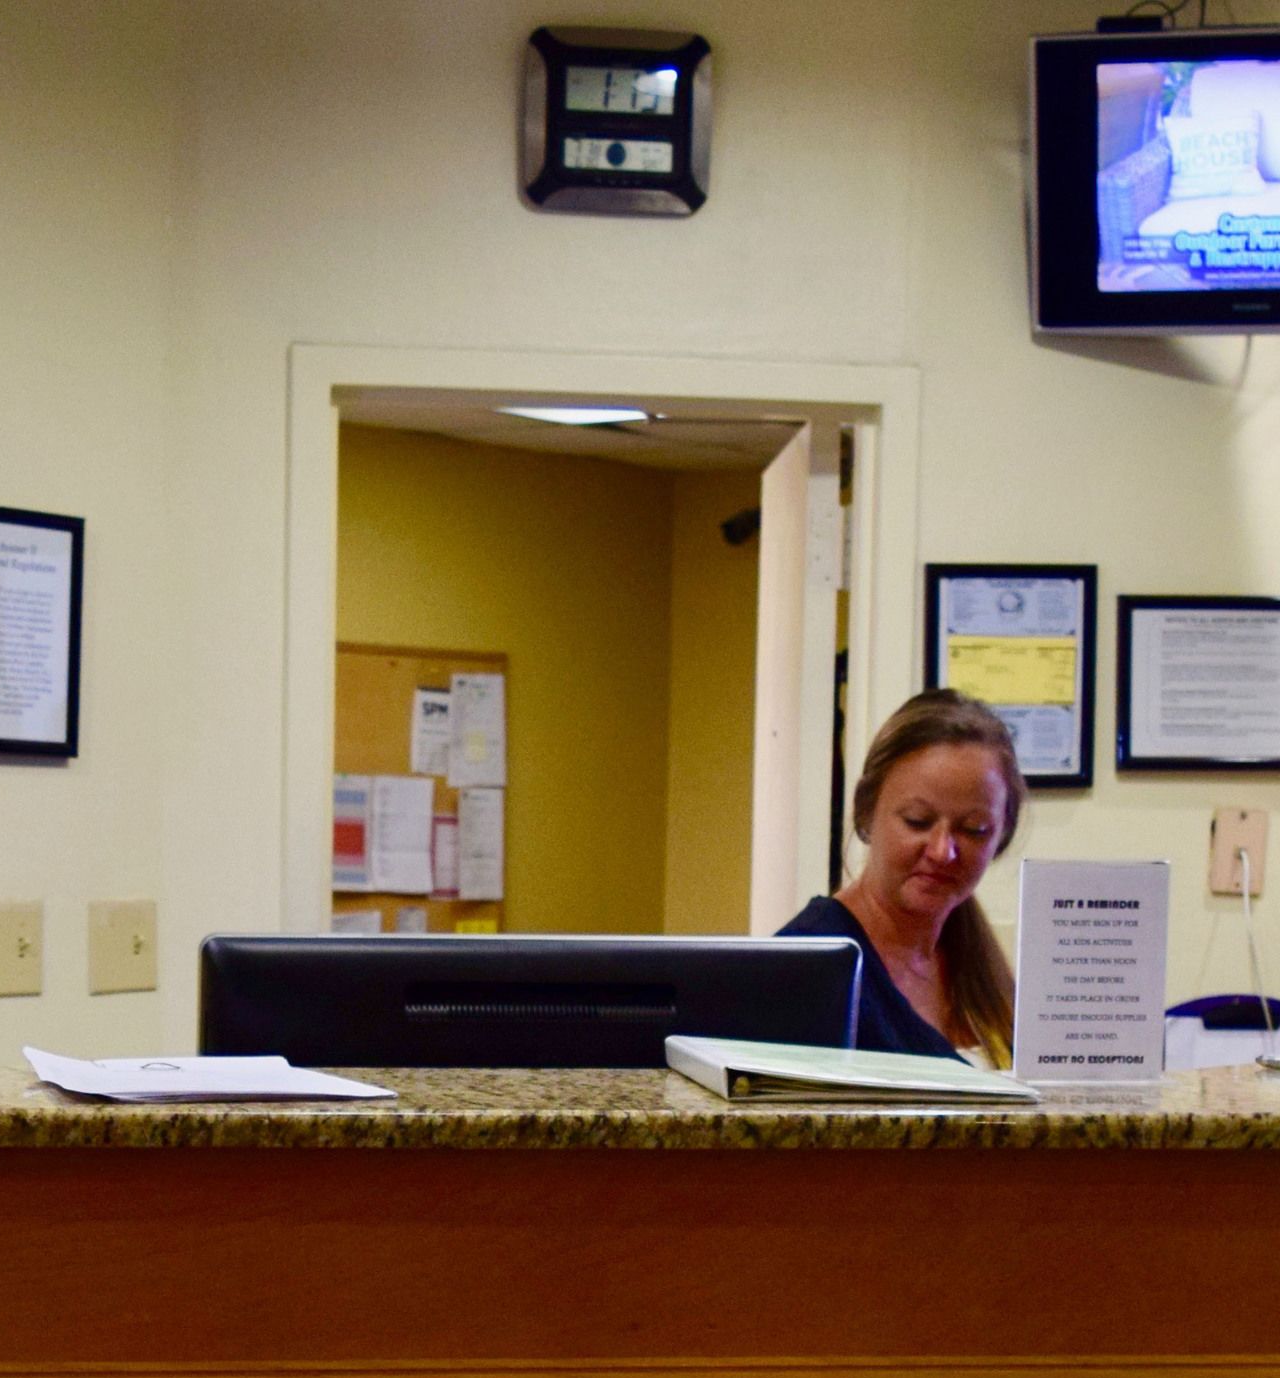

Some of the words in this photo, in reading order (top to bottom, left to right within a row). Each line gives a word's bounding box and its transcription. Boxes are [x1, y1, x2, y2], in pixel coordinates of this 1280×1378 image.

[1053, 899, 1075, 909] JUST
[1077, 899, 1084, 909] A
[1087, 899, 1140, 909] REMINDER
[1052, 919, 1069, 927] YOU
[1080, 976, 1095, 984] DAY
[1038, 1055, 1069, 1064] SORRY
[1071, 1055, 1085, 1064] NO
[1087, 1055, 1144, 1064] EXCEPTIONS
